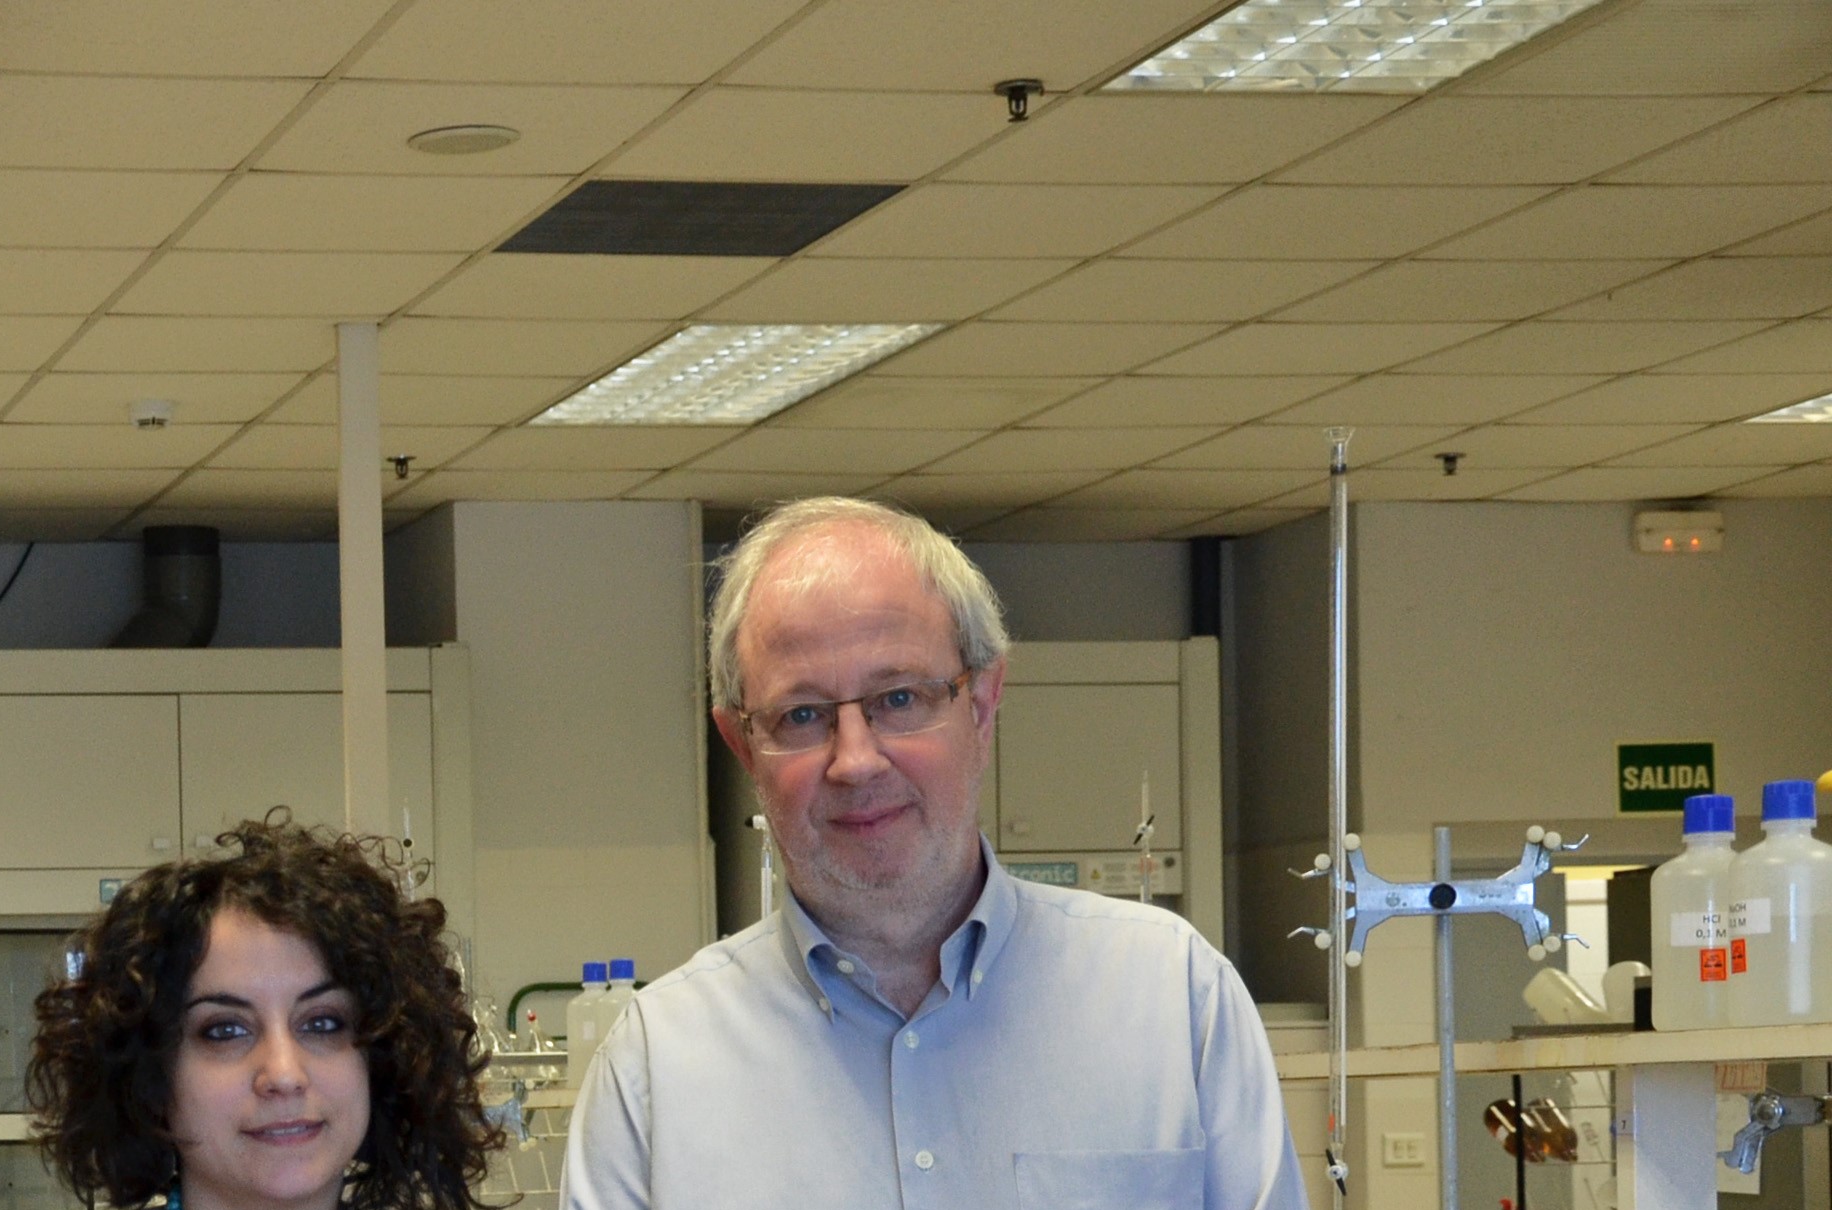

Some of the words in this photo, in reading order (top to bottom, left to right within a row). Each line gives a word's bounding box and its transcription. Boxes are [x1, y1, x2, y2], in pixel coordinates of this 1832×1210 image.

[1623, 765, 1710, 790] SALIDA
[1702, 914, 1722, 924] HCl
[1715, 928, 1727, 938] M
